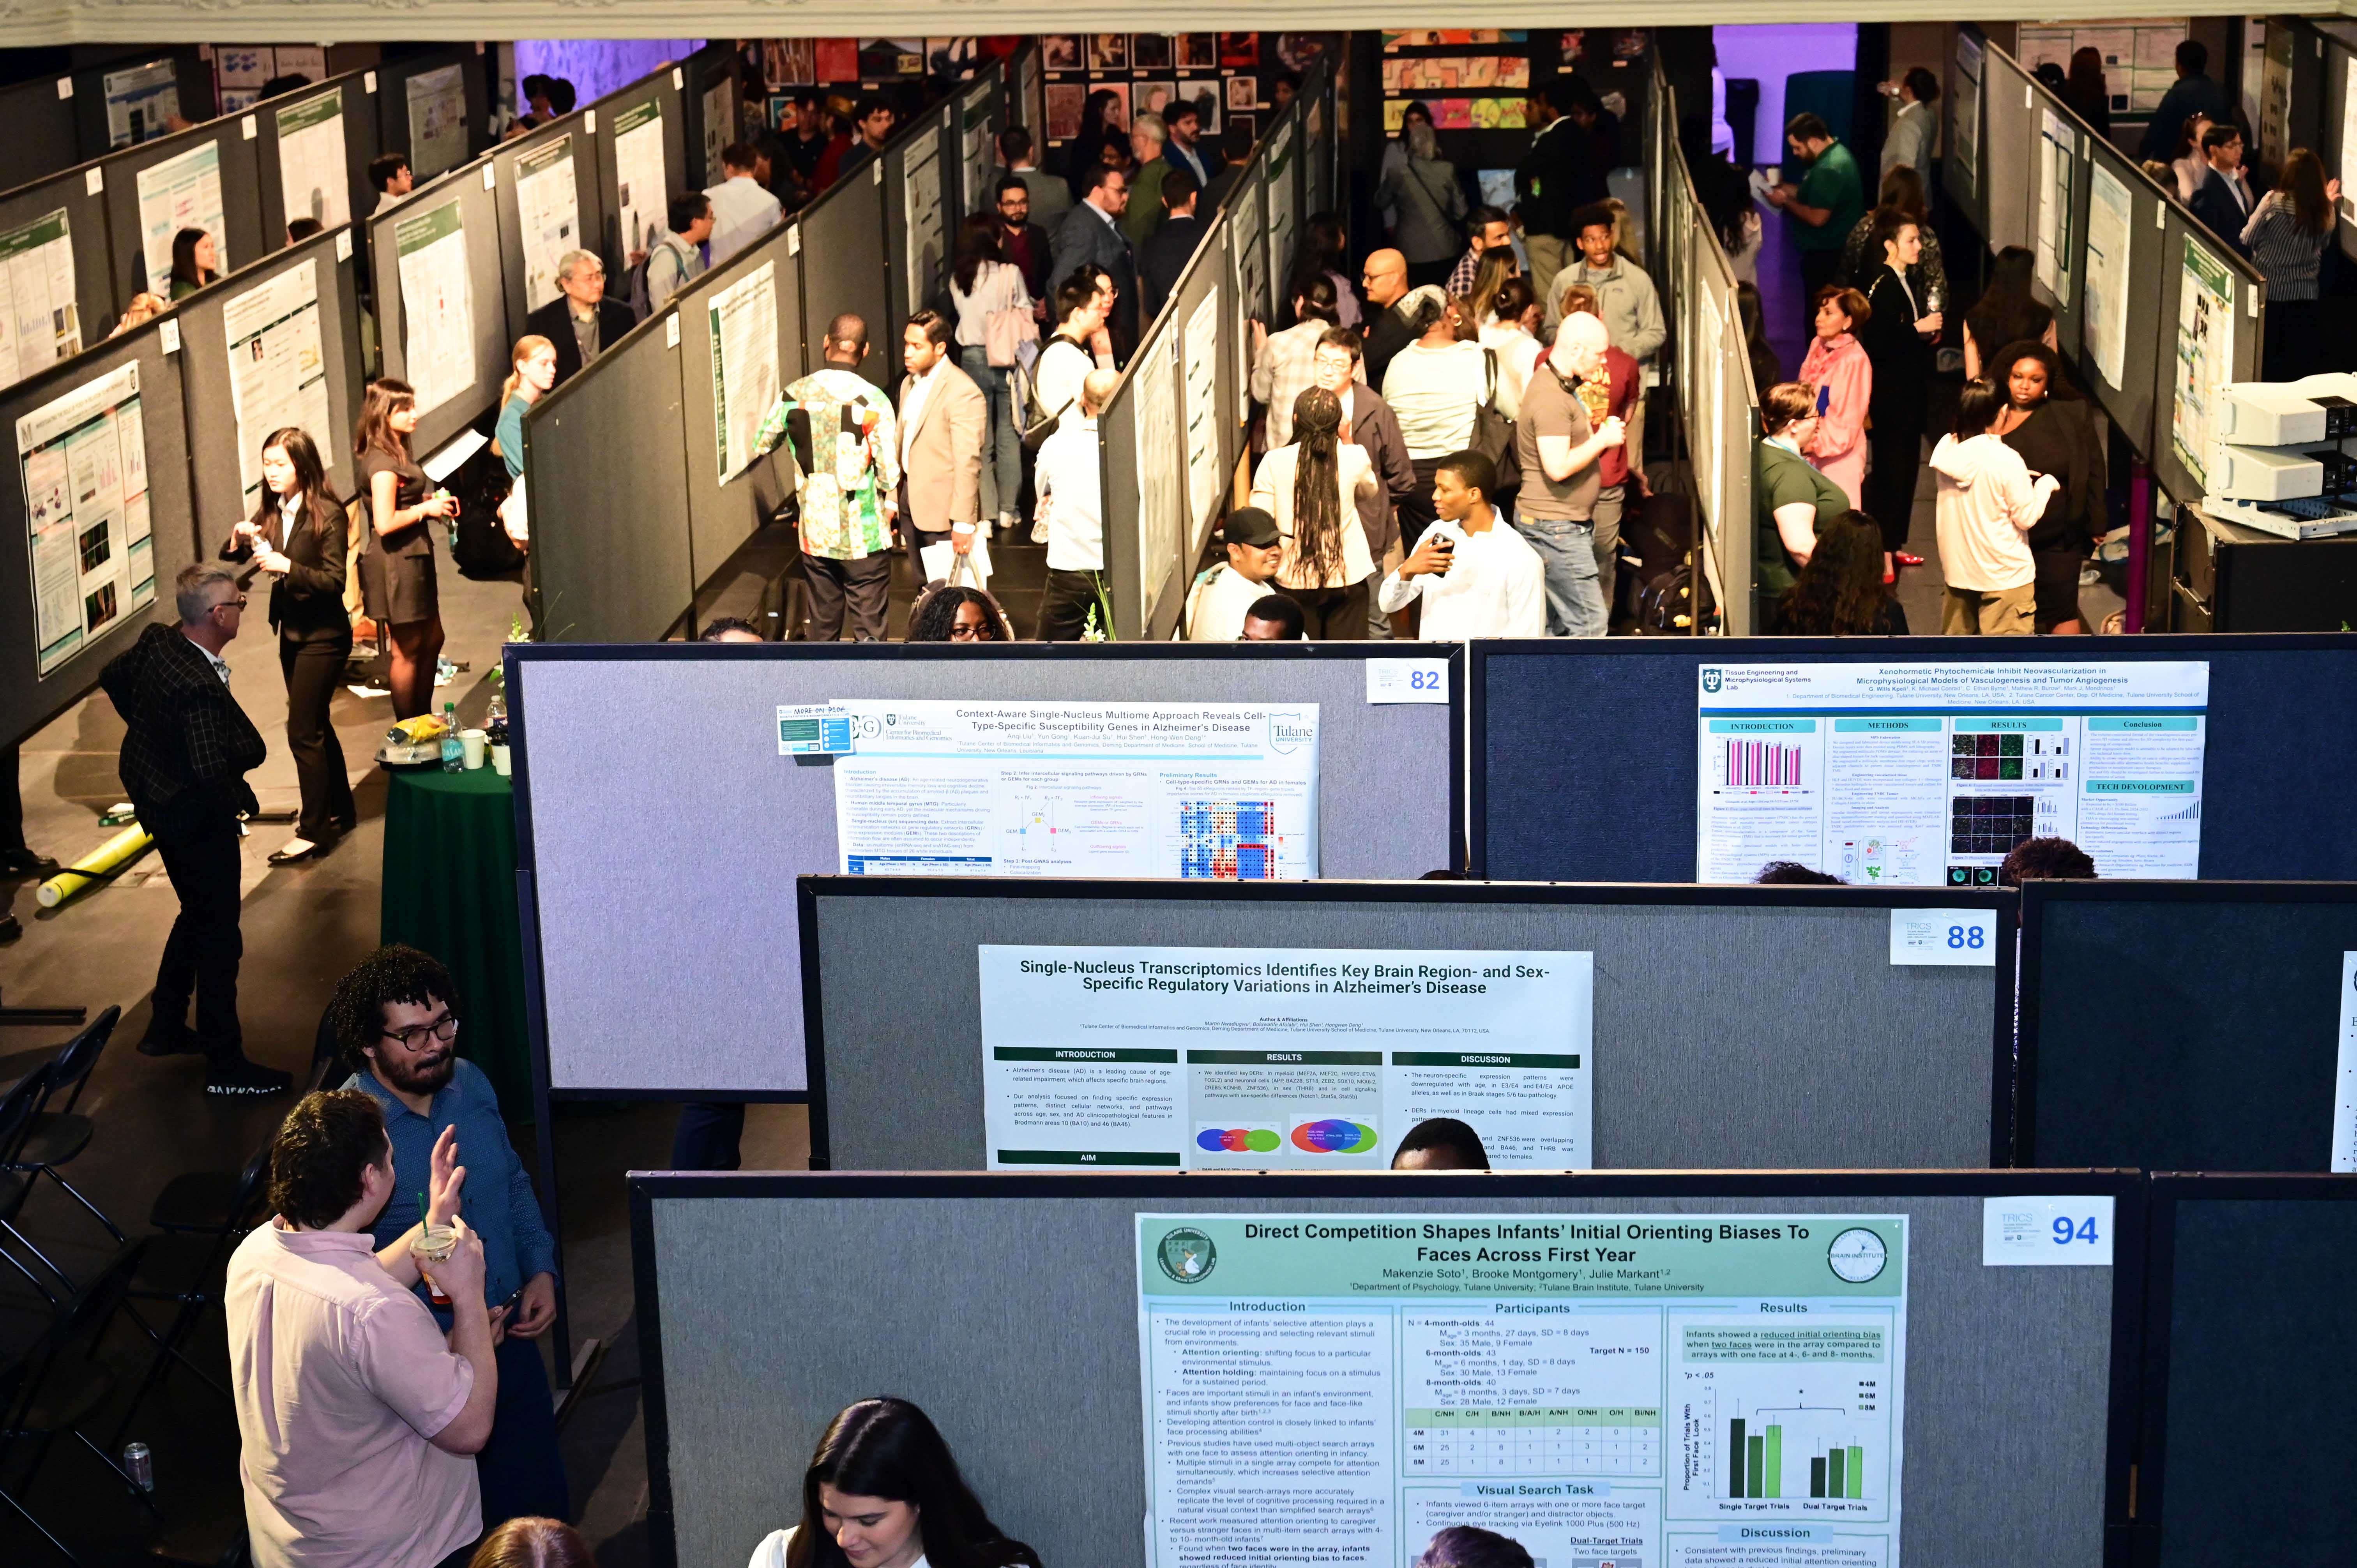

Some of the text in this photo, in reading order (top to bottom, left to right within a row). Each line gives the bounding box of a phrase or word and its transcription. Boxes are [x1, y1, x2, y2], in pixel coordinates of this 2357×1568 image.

[1411, 671, 1439, 689] 82
[956, 710, 1026, 718] Context-Aware
[1030, 710, 1102, 720] Single-Nucleus
[1106, 711, 1149, 719] Multiome
[1152, 711, 1199, 721] Approach
[972, 722, 1035, 731] Type-Specific
[1039, 722, 1104, 735] Susceptibility
[1273, 725, 1313, 736] Tulane
[1947, 926, 1984, 948] 88
[1020, 960, 1550, 981] Single-Nucleus Transcriptomics Identifies Key Brain Region- and Sex-
[1083, 976, 1486, 994] Specific Regulatory Variations in Alzheimer’s Disease
[2001, 1213, 2032, 1223] TRICS
[1246, 1224, 1809, 1243] Direct Competition Shapes Infants’ Initial Orienting Biases To
[2053, 1217, 2098, 1244] 94
[1418, 1247, 1636, 1262] Faces Across First Year
[1230, 1301, 1305, 1311] Introduction
[1496, 1303, 1570, 1315] Participants
[1760, 1303, 1808, 1312] Results
[1823, 1331, 1860, 1339] orienting
[1477, 1484, 1594, 1495] Visual Search Task
[1741, 1528, 1810, 1537] Discussion
